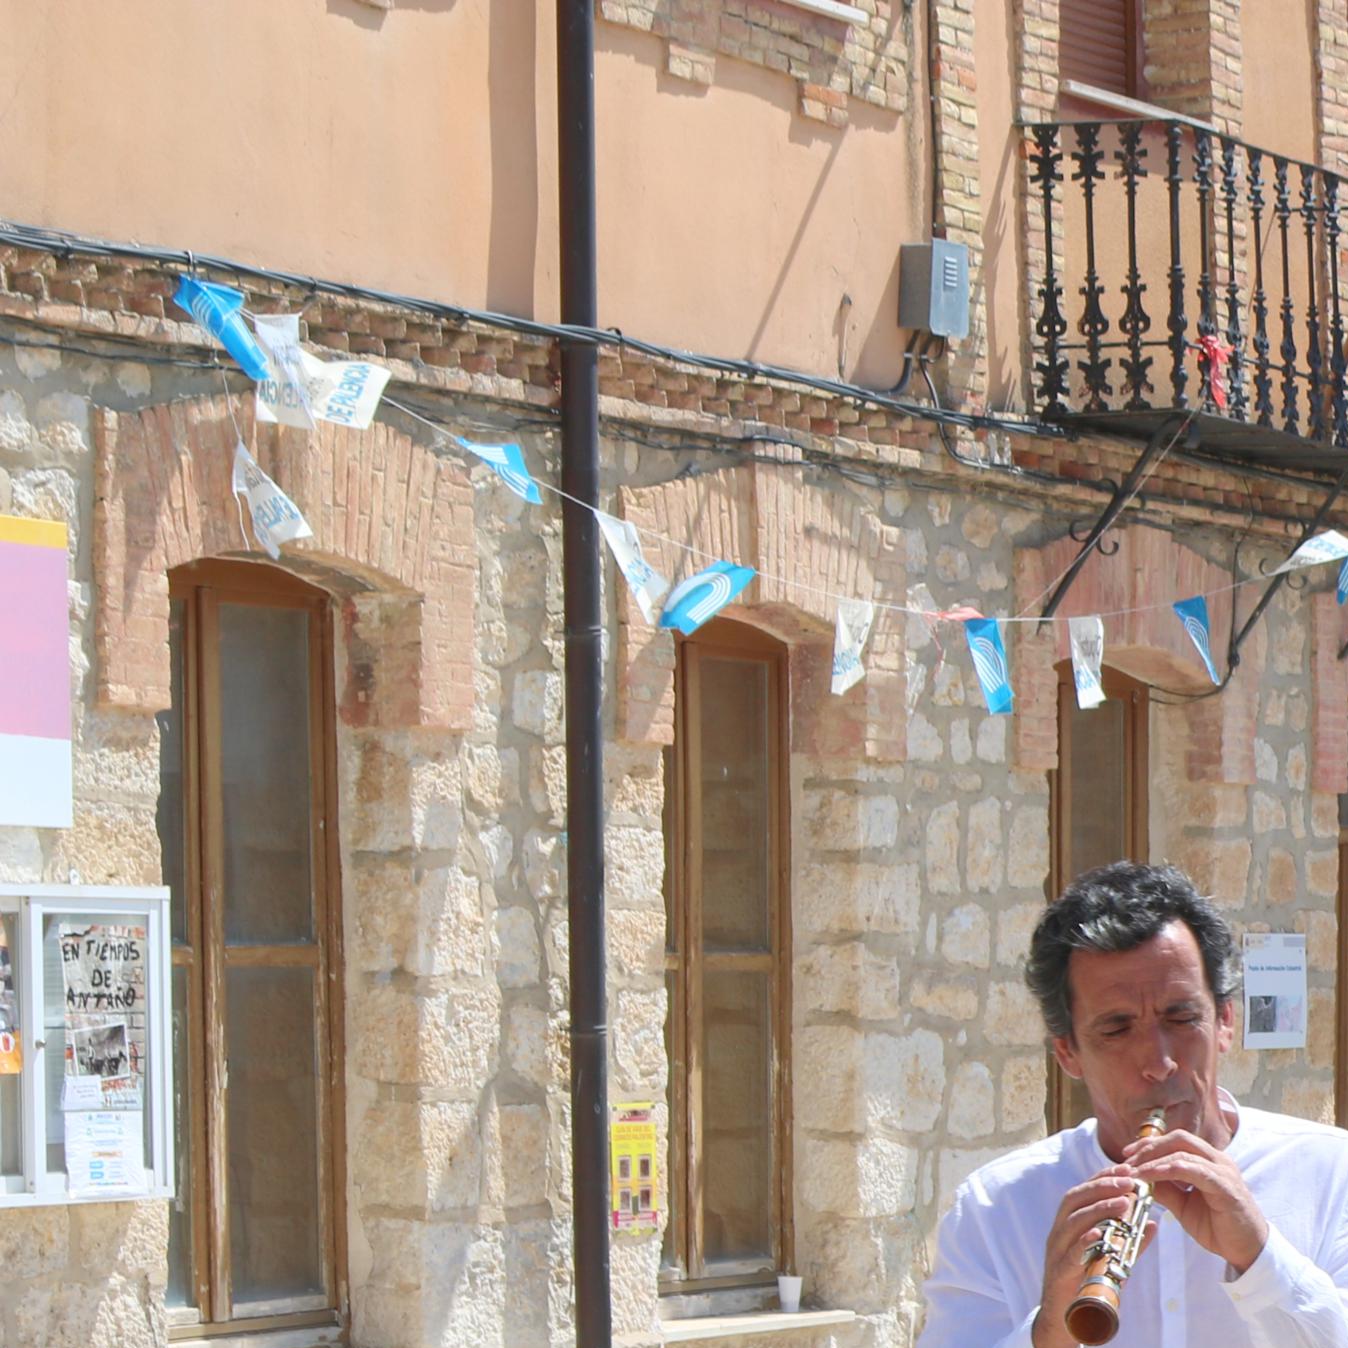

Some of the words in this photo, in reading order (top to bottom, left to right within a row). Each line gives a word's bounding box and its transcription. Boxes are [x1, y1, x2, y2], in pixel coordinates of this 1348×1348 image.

[327, 364, 371, 411] PALENCIA
[325, 404, 355, 424] DE
[62, 943, 80, 962] EN
[86, 939, 140, 961] TIEMPOS
[91, 968, 112, 988] DE
[66, 986, 136, 1009] ANTAÑO
